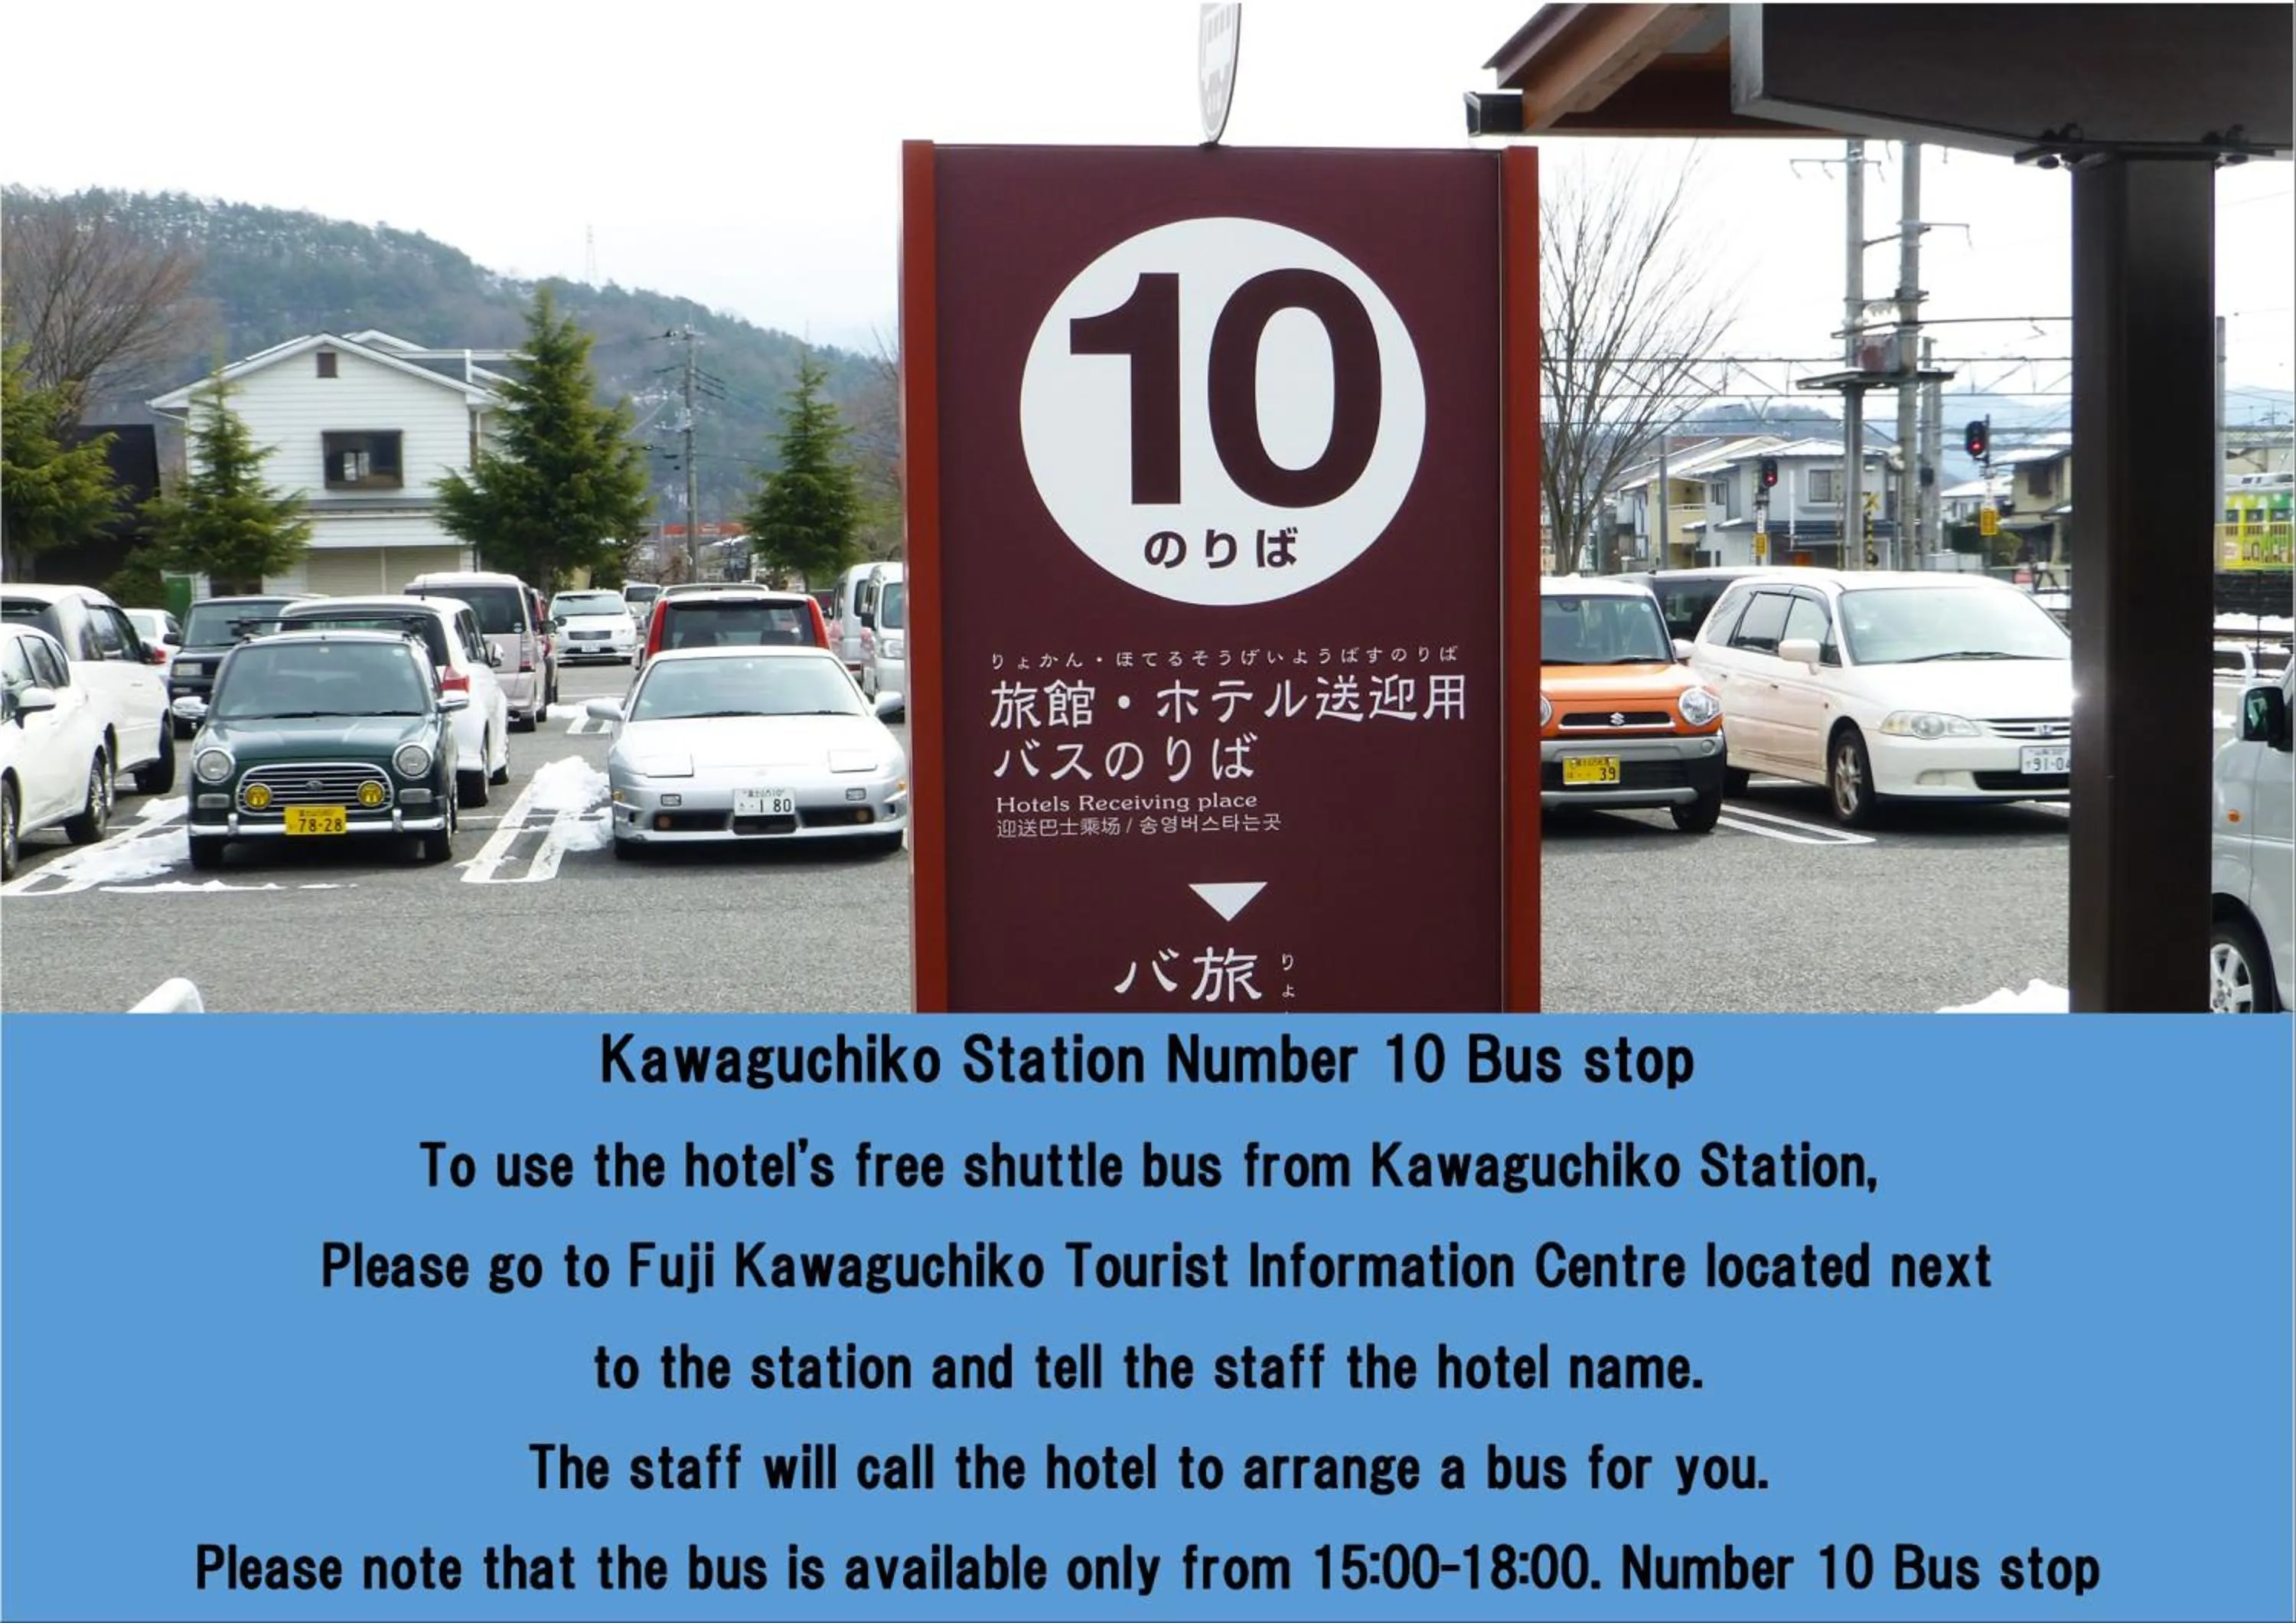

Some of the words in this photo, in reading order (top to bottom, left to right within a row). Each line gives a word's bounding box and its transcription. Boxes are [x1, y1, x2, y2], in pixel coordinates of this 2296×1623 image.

[1070, 267, 1382, 508] 10
[1144, 527, 1298, 569] のりば
[990, 674, 1466, 730] 旅館・ホテル送迎用
[993, 732, 1259, 782] バスのりば
[997, 796, 1070, 814] Hotels
[1079, 794, 1190, 812] Receiving
[1199, 792, 1257, 812] place
[1138, 813, 1282, 834] 송영버스타는곳
[997, 818, 1121, 839] 迎送巴士乘场
[1282, 954, 1295, 1014] りょ
